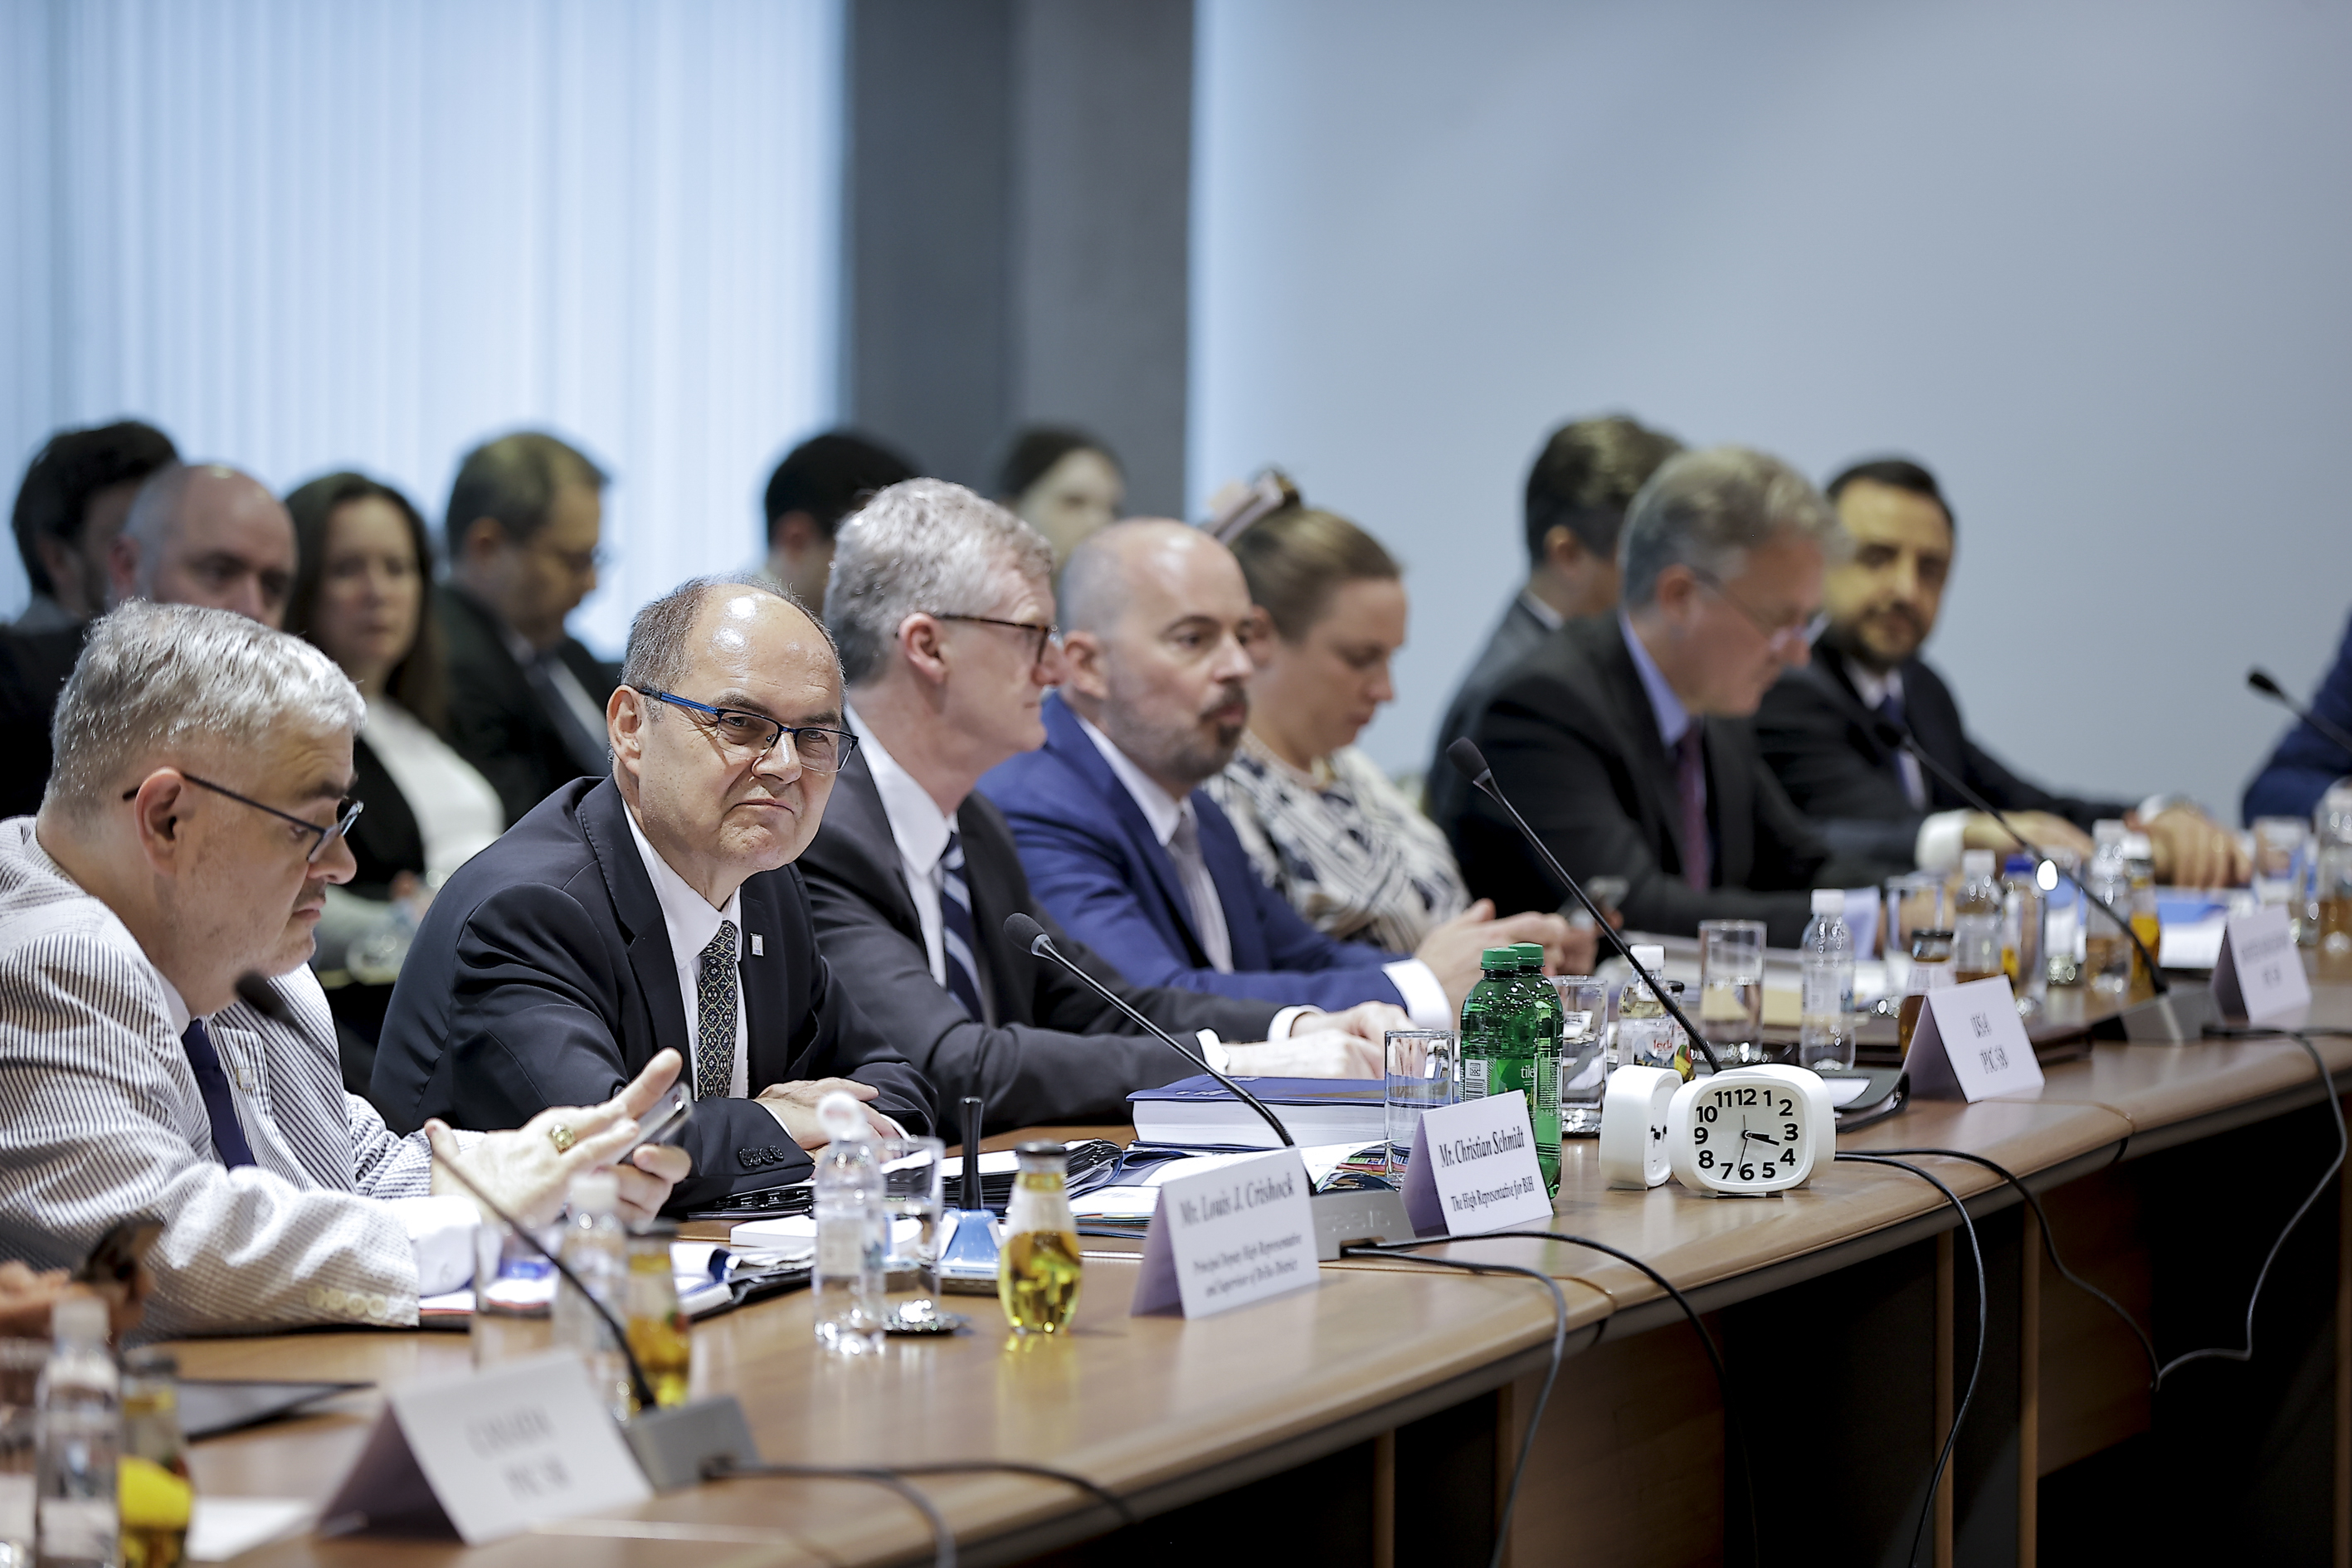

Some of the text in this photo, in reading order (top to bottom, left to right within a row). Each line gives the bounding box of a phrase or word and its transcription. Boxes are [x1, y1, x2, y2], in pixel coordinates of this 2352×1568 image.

[1714, 1090, 1732, 1108] 11
[1734, 1088, 1757, 1106] 12
[1763, 1090, 1772, 1107] 1
[1696, 1105, 1718, 1123] 10
[1779, 1098, 1794, 1117] 2
[1694, 1127, 1709, 1145] 9
[1784, 1123, 1799, 1142] 3
[1439, 1126, 1525, 1167] Mr. Christian Schmidt
[1698, 1150, 1715, 1169] 8
[1780, 1148, 1796, 1166] 4
[1720, 1162, 1734, 1180] 7
[1739, 1163, 1755, 1181] 6
[1761, 1161, 1776, 1179] 5
[1450, 1176, 1535, 1211] The High Representative for BiH
